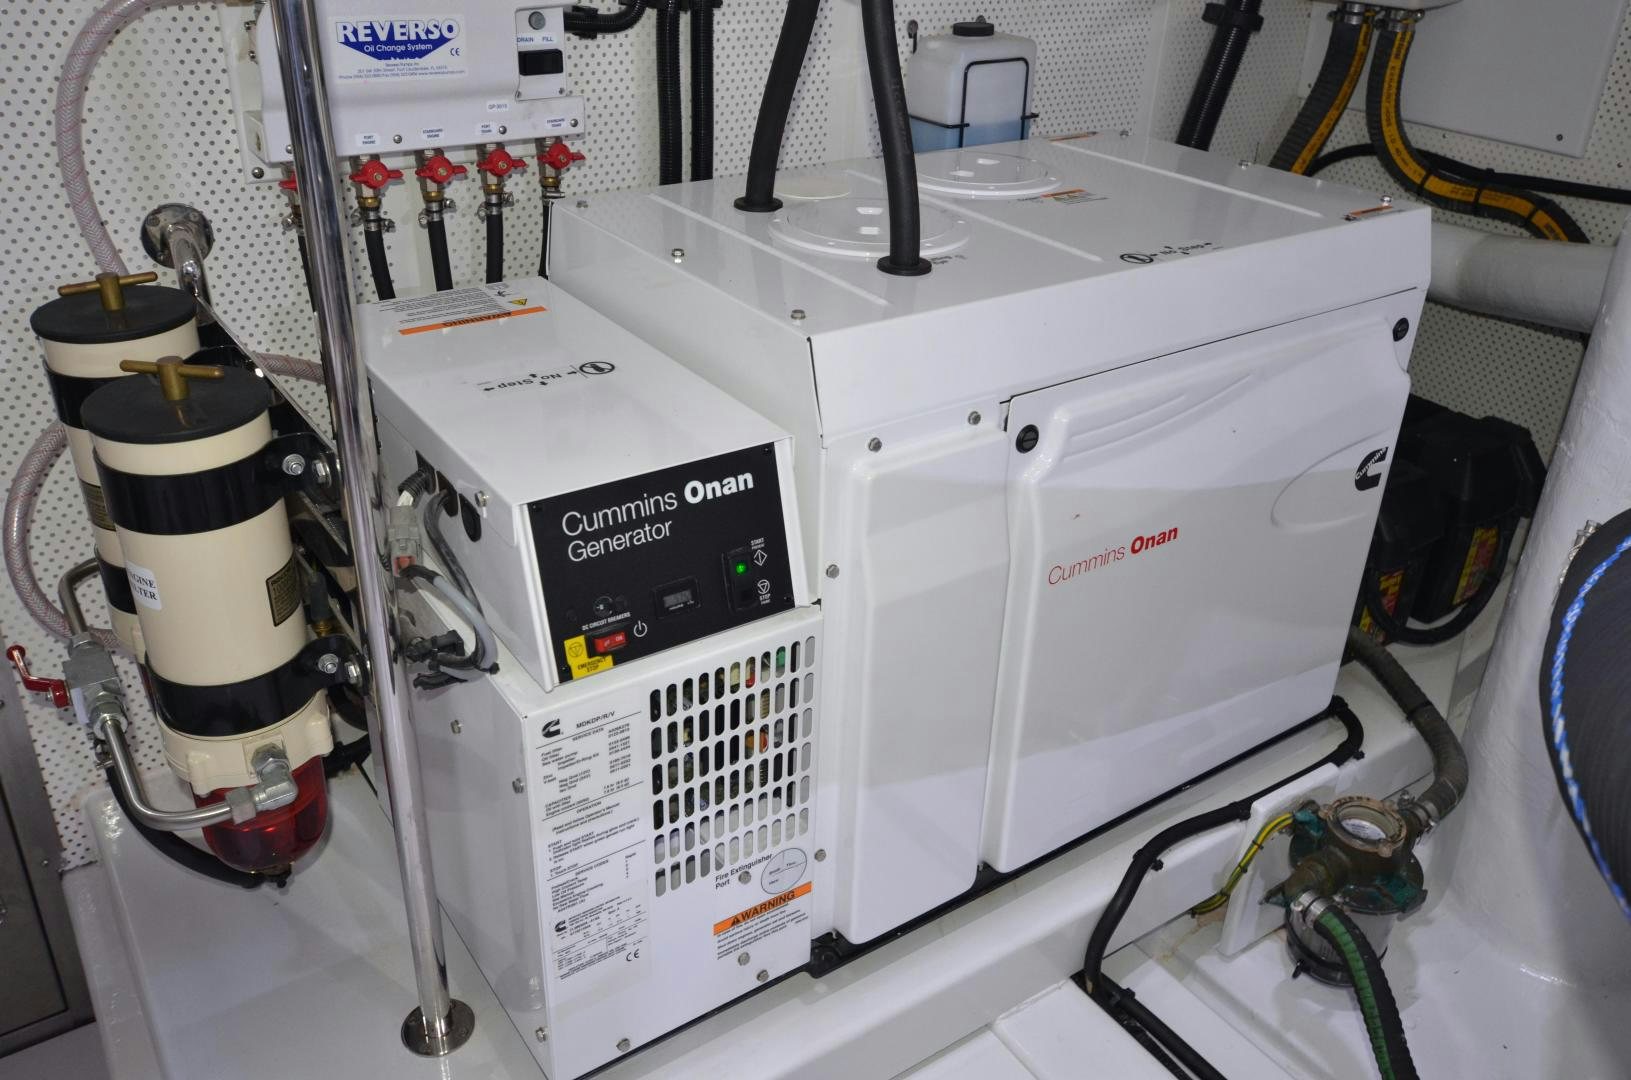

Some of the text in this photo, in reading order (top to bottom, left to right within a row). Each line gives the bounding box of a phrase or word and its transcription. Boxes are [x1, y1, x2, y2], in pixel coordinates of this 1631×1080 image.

[336, 18, 460, 43] REVERSO
[376, 44, 406, 52] Change
[408, 43, 433, 52] System
[498, 379, 533, 389] Step
[562, 472, 754, 536] Cummins Onan
[568, 520, 672, 562] Generator
[1048, 527, 1178, 585] Cummins Onan
[582, 611, 631, 631] DC CIRCUIT BREAKERS
[577, 657, 606, 672] EMERGENCY
[716, 872, 729, 882] Fire
[730, 854, 772, 875] Extinguisher
[716, 880, 730, 889] Port
[741, 890, 796, 920] WARNING
